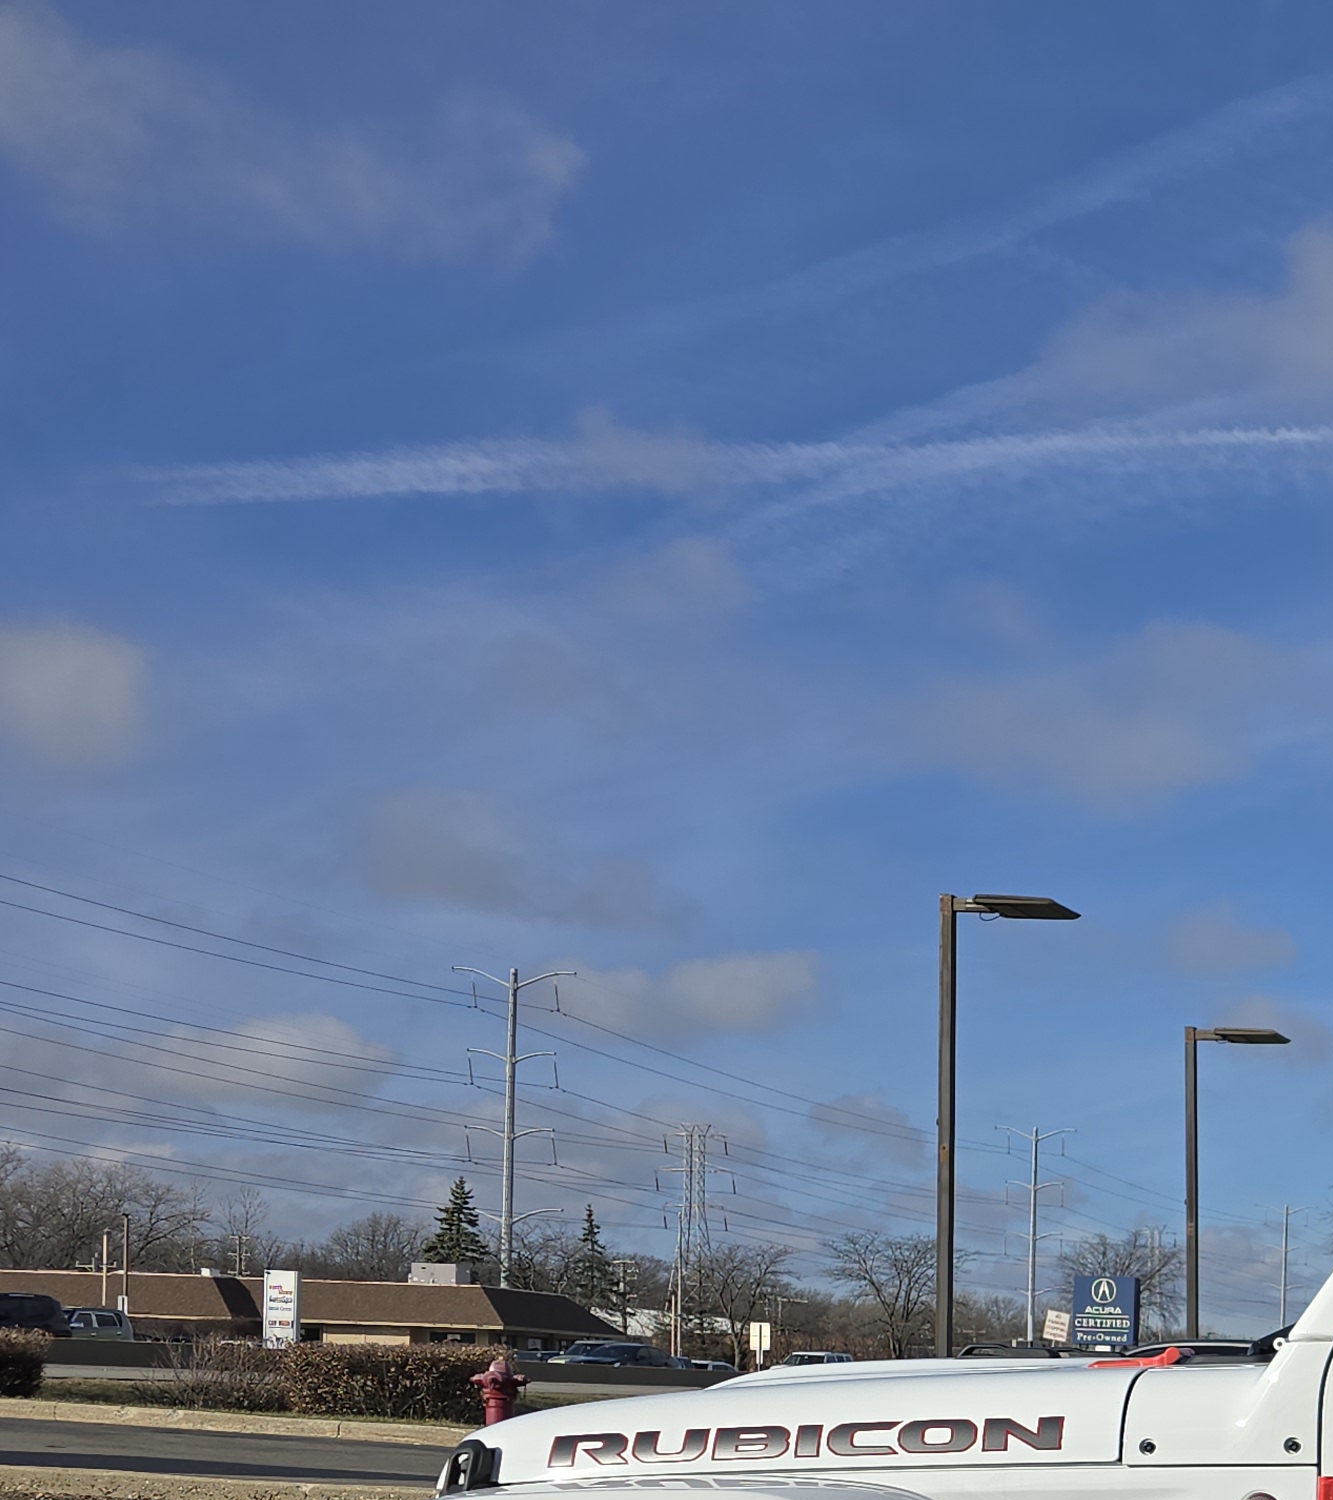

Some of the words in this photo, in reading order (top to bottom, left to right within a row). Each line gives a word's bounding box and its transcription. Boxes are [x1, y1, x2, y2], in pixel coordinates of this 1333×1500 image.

[1084, 1305, 1122, 1314] ACURA
[1074, 1318, 1130, 1328] CERTIFIED
[547, 1415, 1065, 1468] RUBICON
